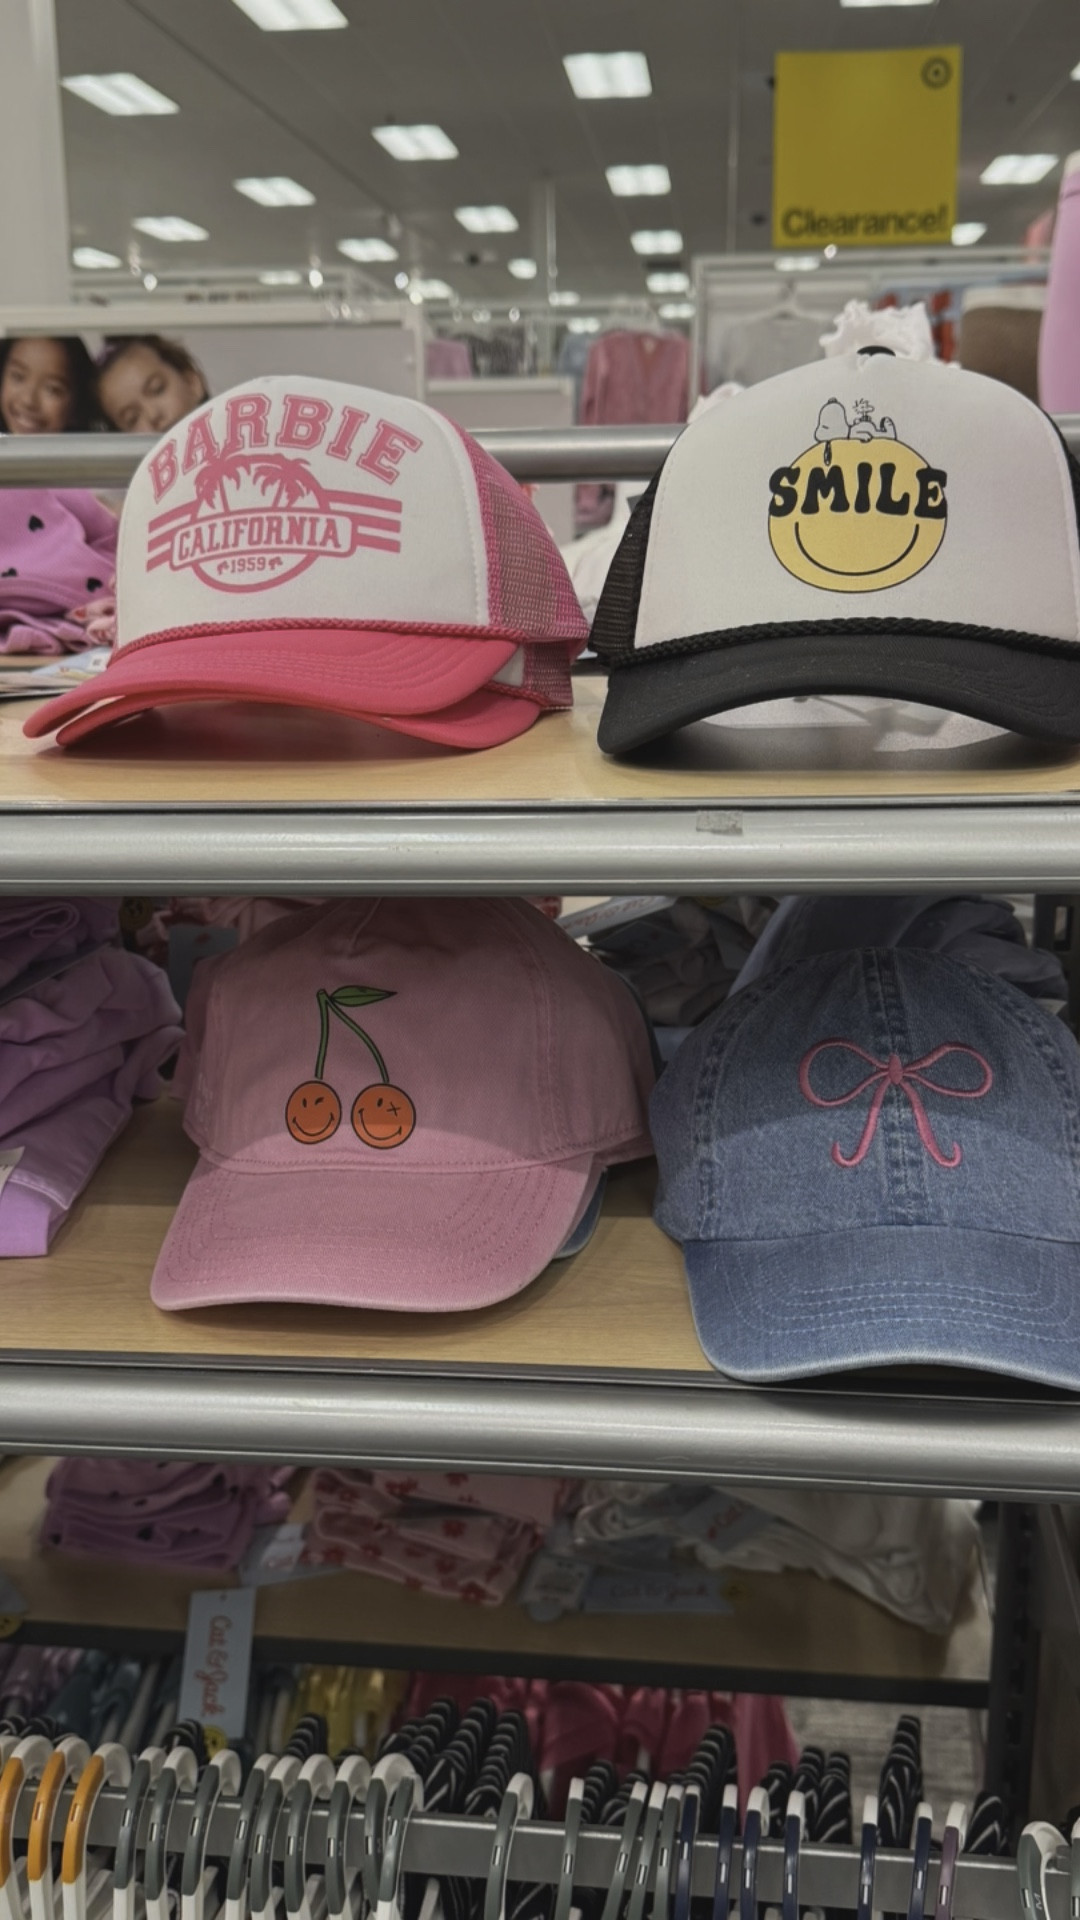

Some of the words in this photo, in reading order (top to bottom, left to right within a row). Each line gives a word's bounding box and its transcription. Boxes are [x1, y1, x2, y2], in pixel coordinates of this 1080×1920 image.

[782, 203, 948, 238] Clearance!
[148, 394, 423, 503] BARBIE
[769, 462, 947, 519] SMILE
[178, 515, 341, 560] CALIFORNIA
[230, 556, 266, 573] 1959
[209, 1615, 232, 1647] Cat
[193, 1669, 229, 1717] Jack
